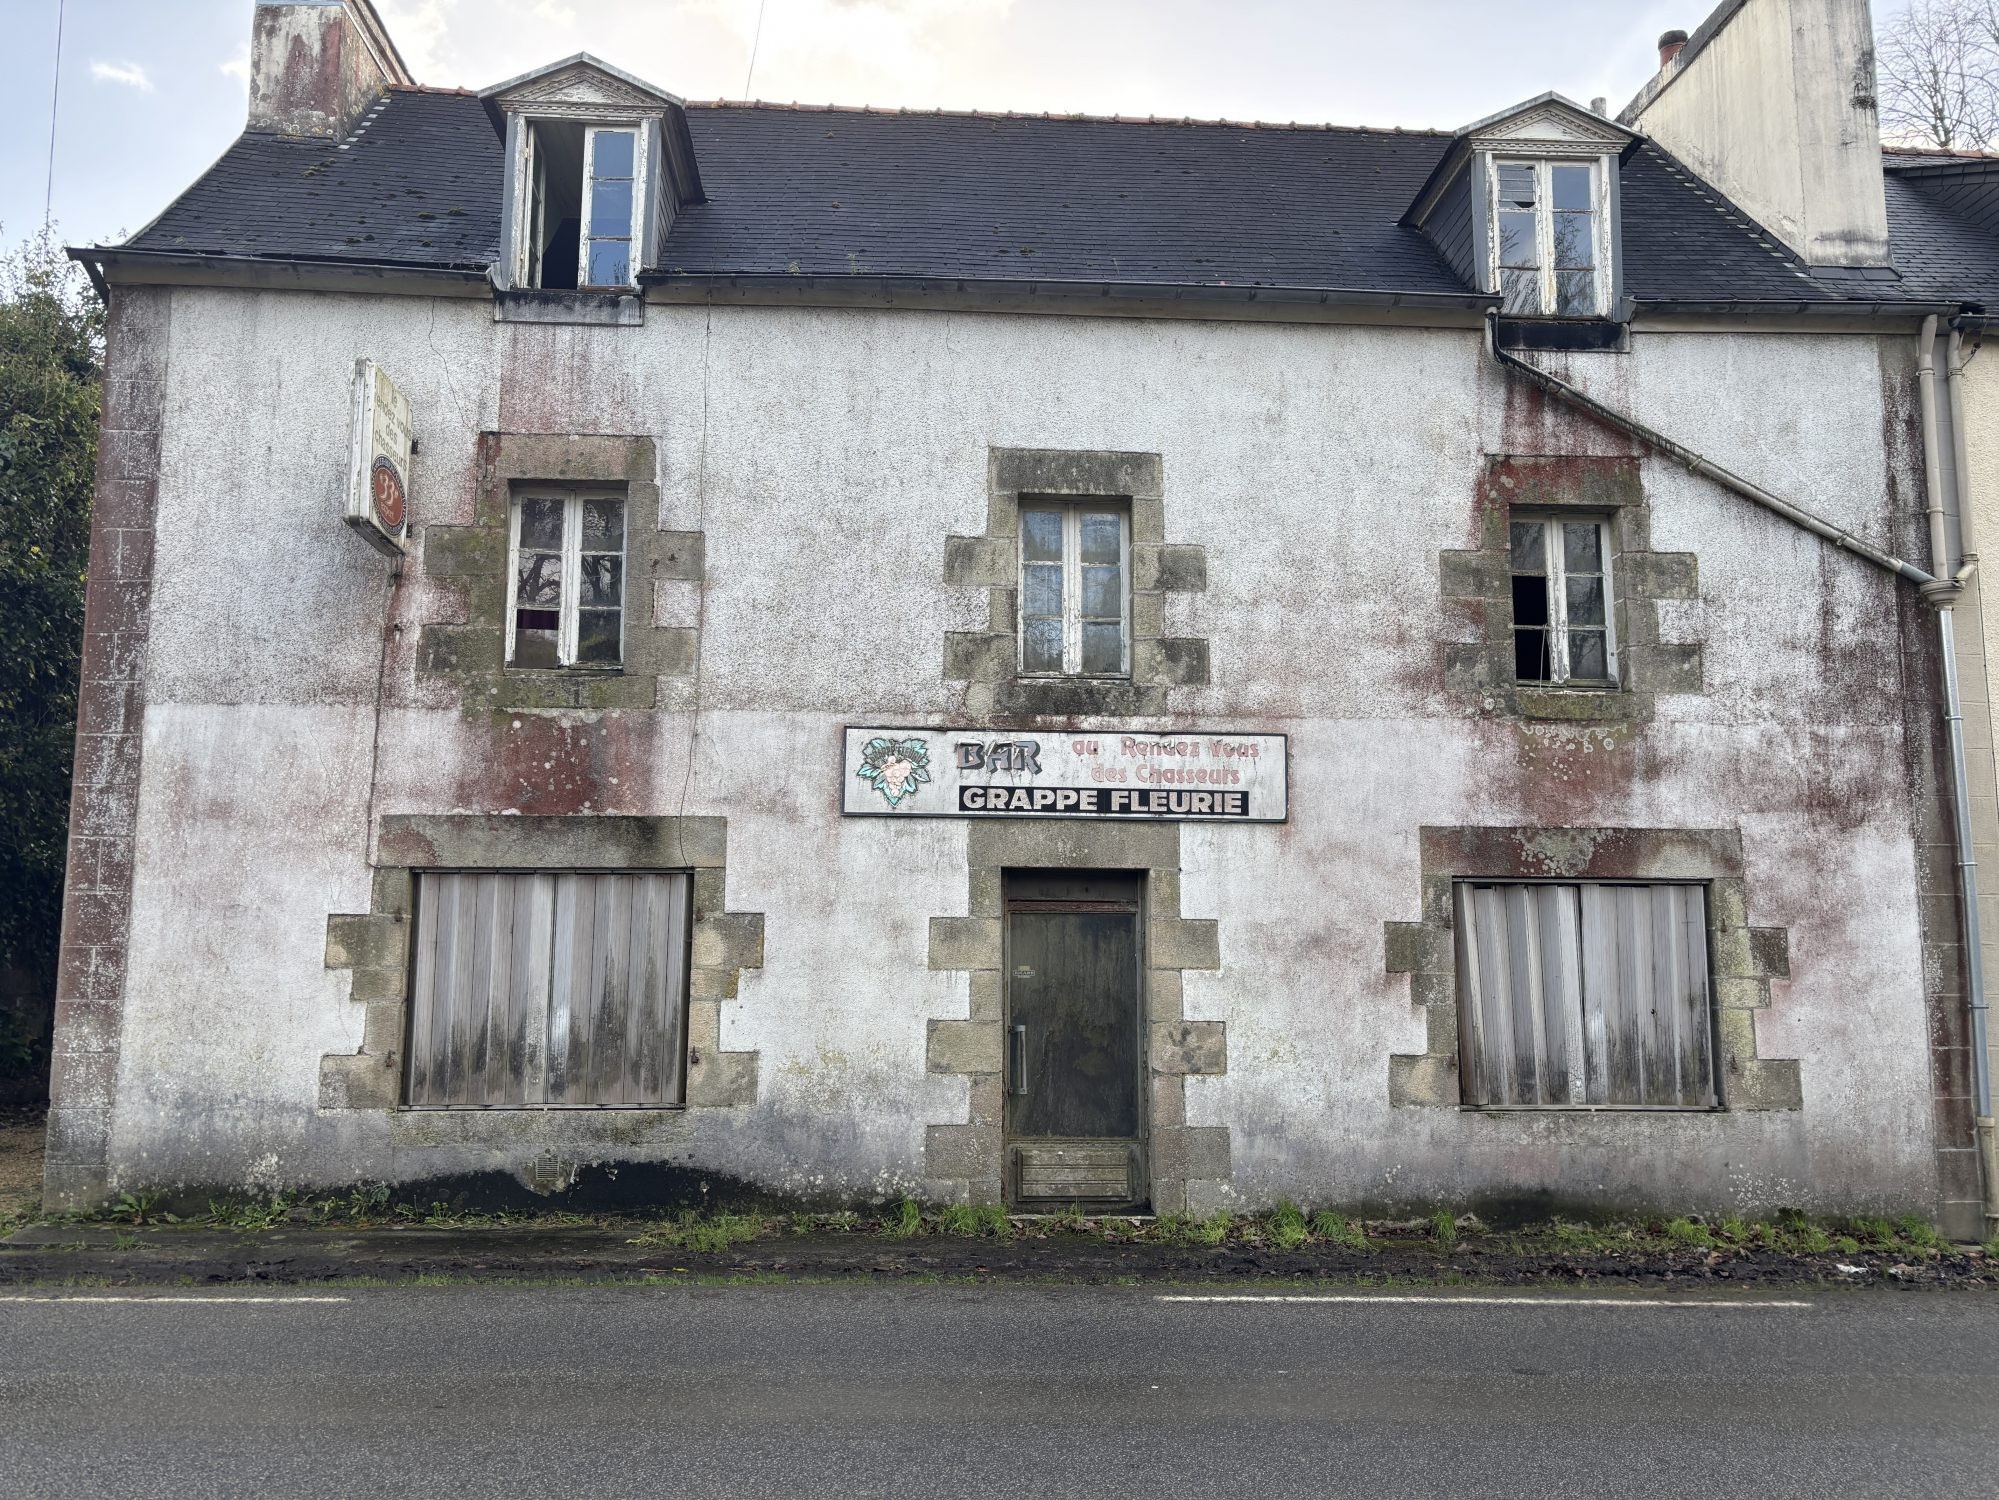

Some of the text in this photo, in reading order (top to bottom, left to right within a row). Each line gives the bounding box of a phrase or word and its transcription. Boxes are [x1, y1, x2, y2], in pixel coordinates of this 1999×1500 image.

[386, 422, 398, 445] des
[374, 429, 407, 472] chasseurs
[957, 736, 1260, 775] BAR au Rendez Vous
[1091, 764, 1240, 784] des Chasseurs
[963, 787, 1242, 813] GRAPPE FLEURIE
